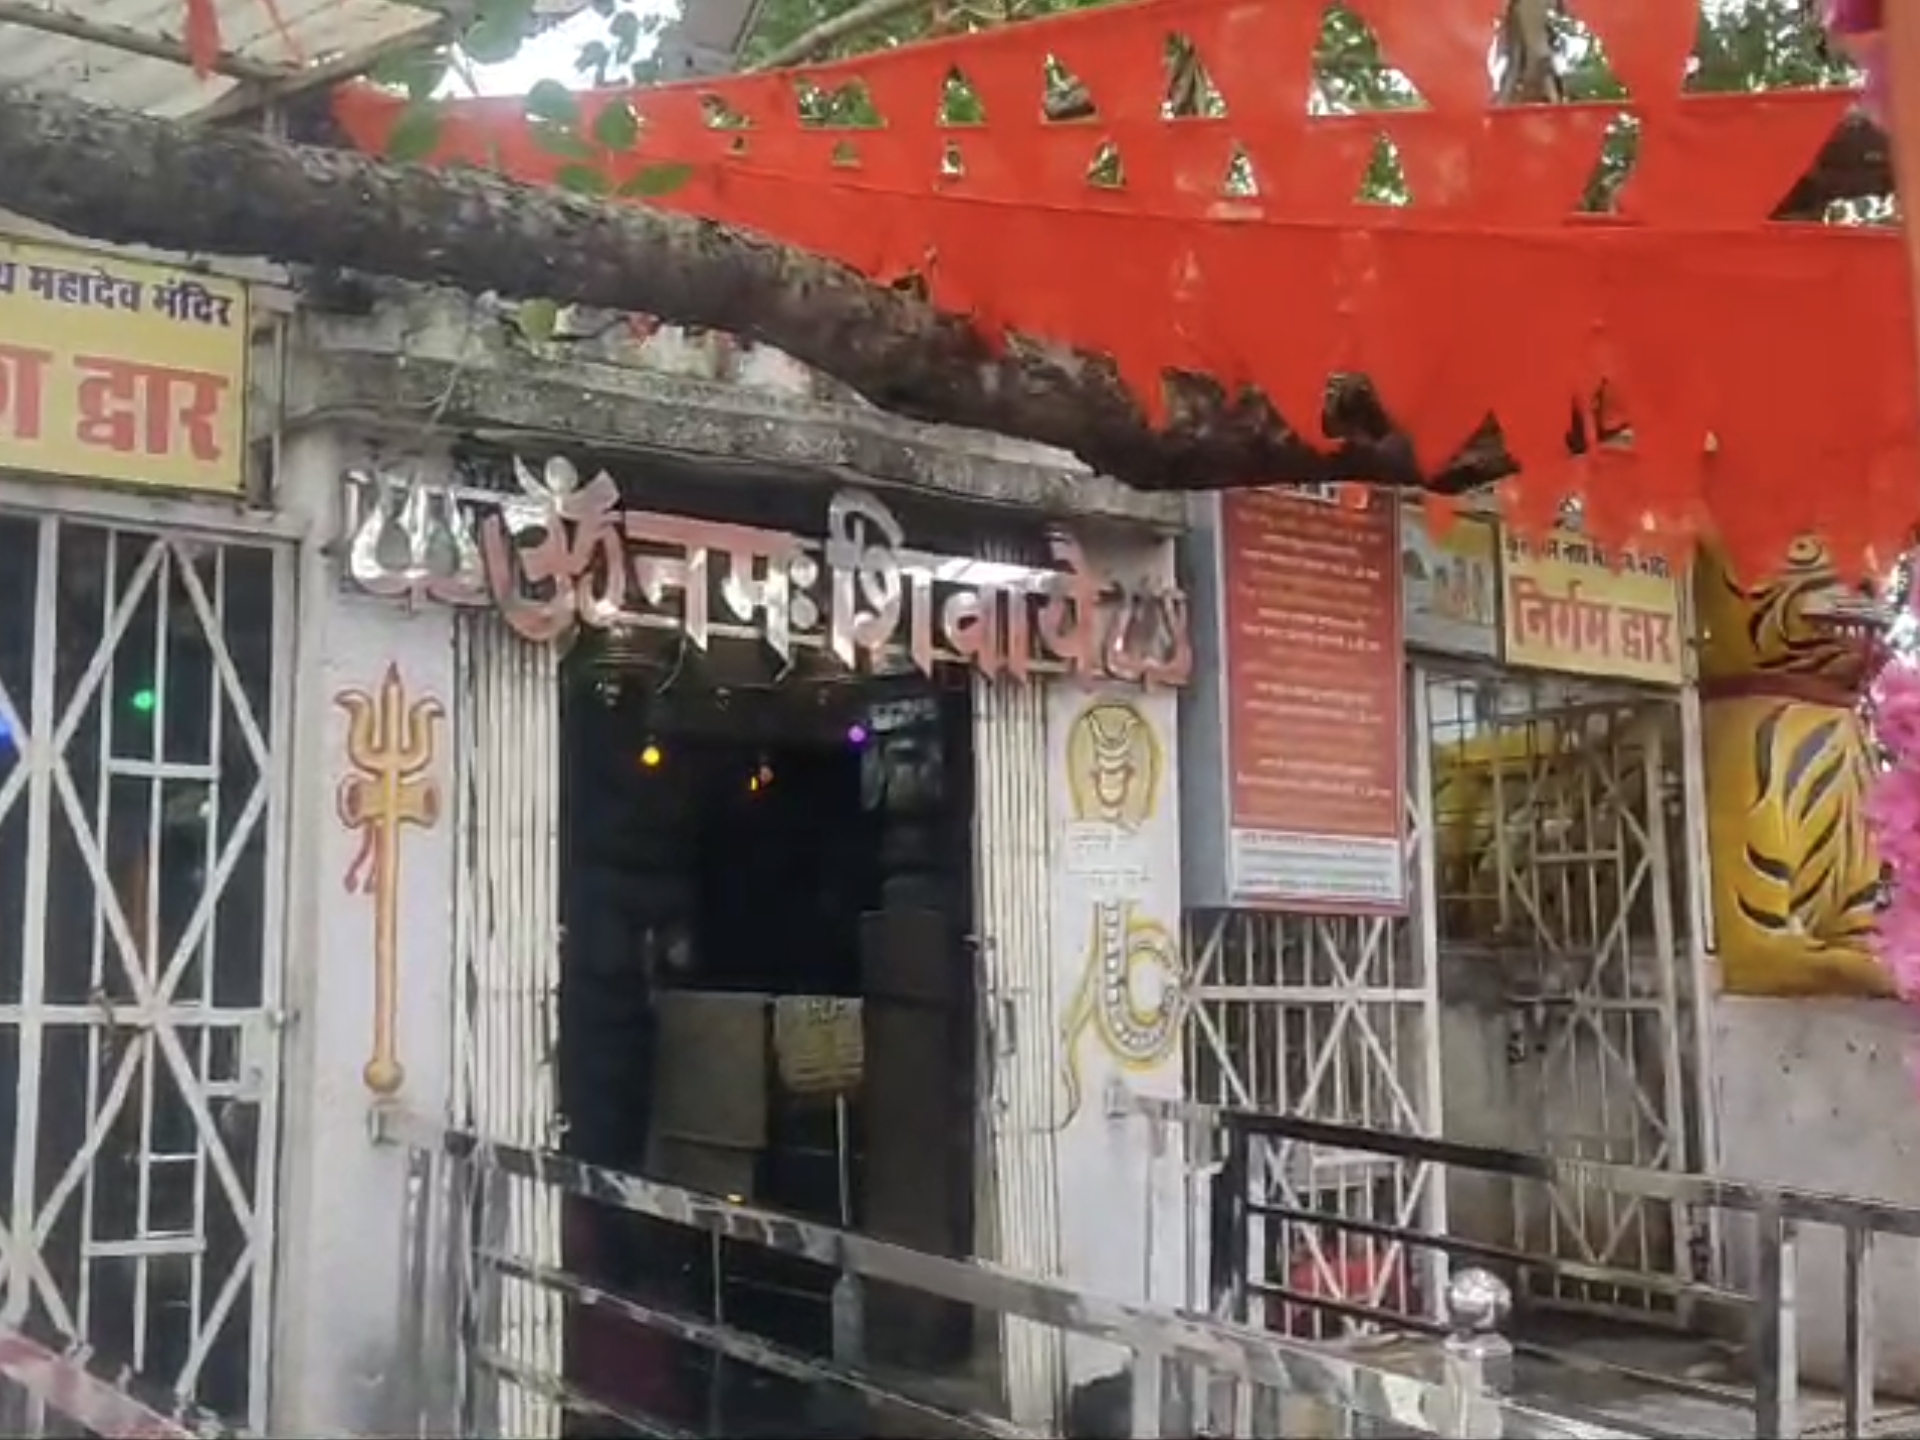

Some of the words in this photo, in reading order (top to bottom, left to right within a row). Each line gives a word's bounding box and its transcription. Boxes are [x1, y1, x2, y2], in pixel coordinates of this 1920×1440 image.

[30, 264, 142, 312] महादेव
[152, 279, 233, 327] मंदिर
[73, 354, 229, 462] द्वार
[1509, 574, 1612, 657] निर्गम
[1618, 605, 1674, 664] द्वार
